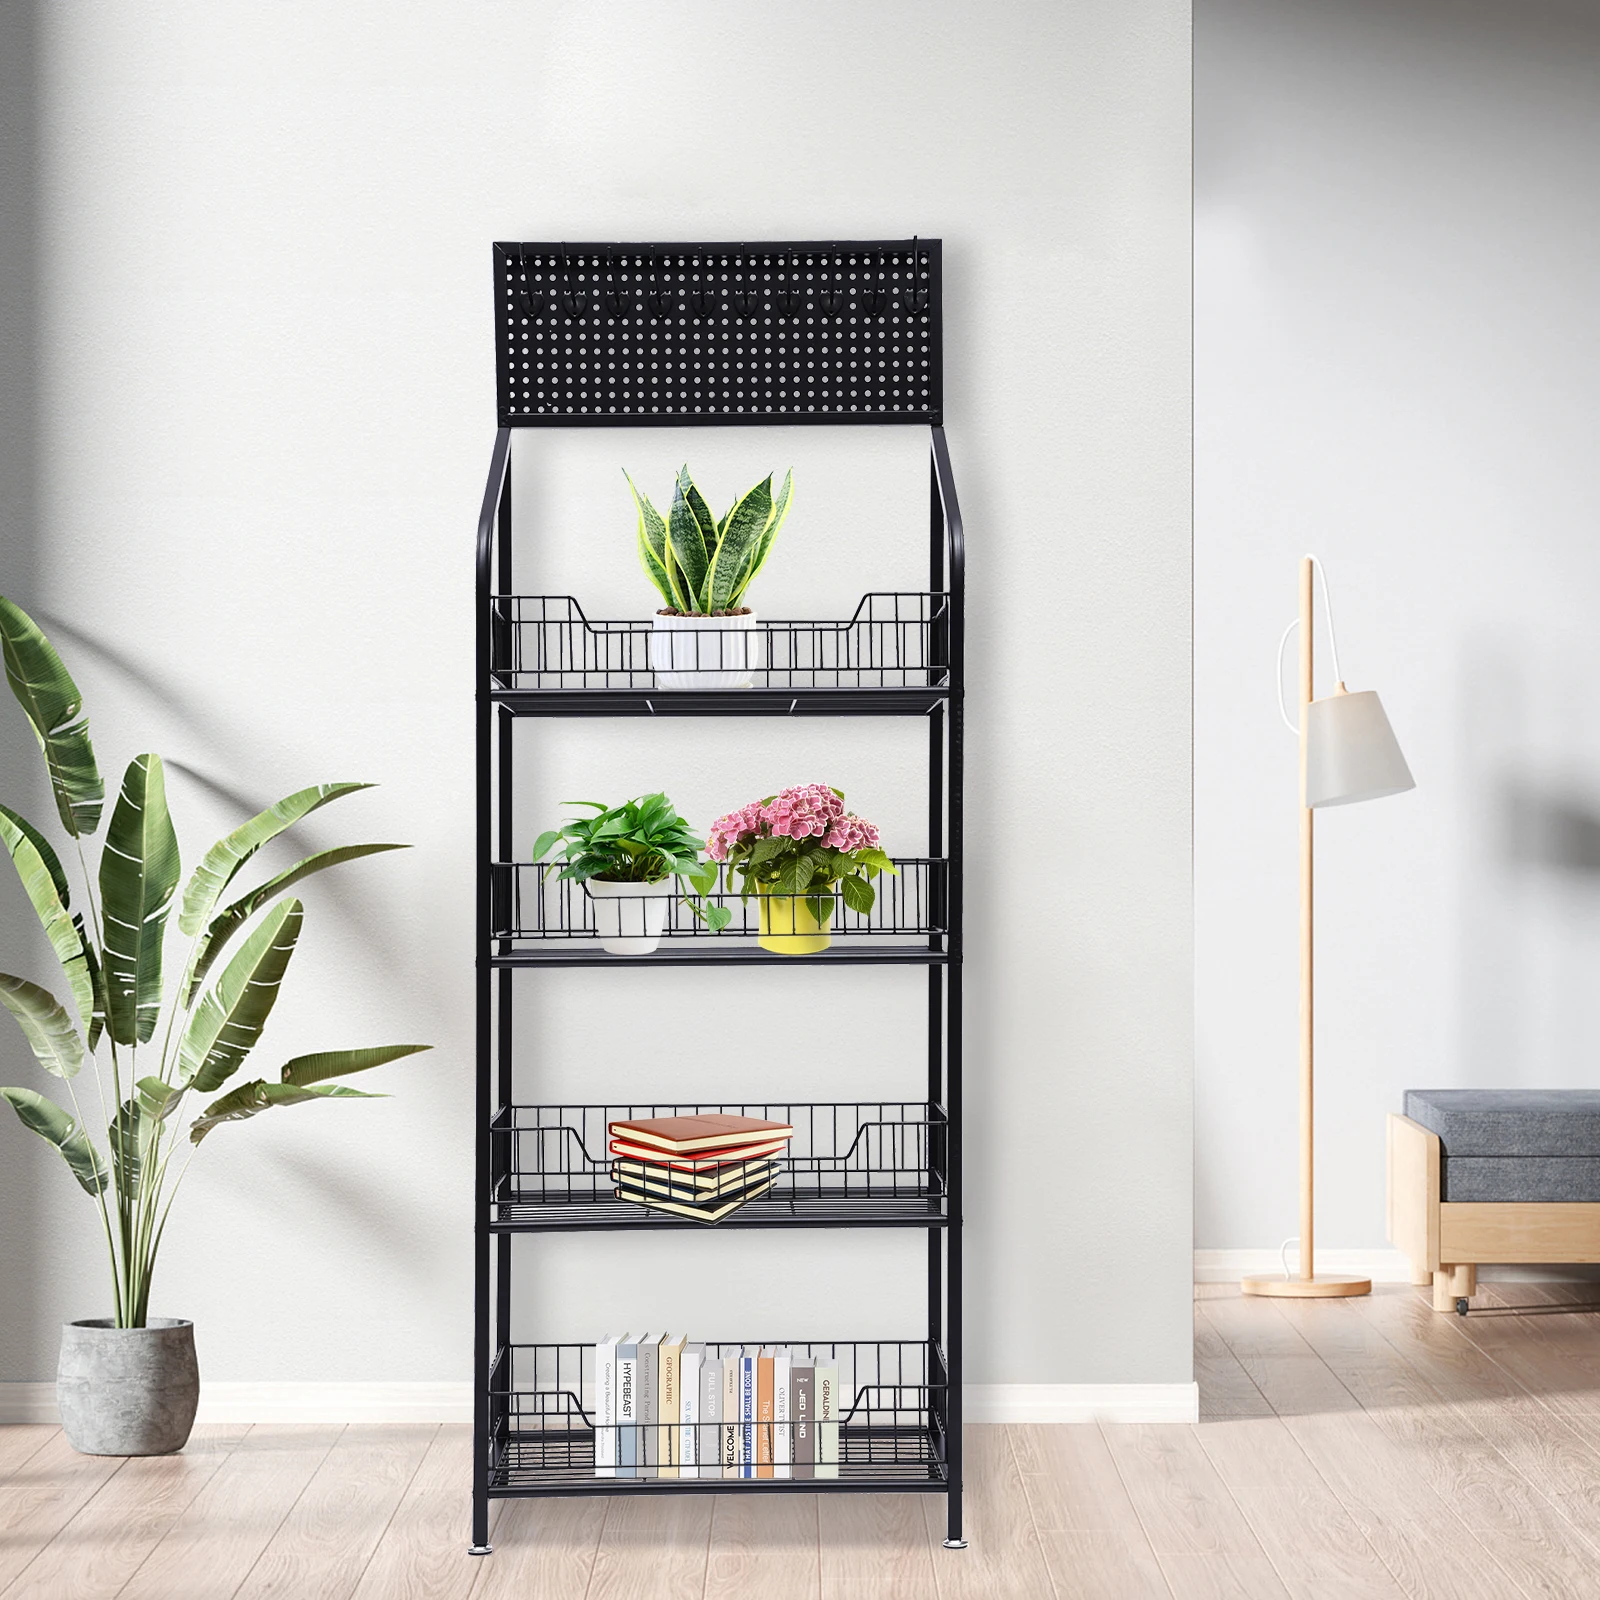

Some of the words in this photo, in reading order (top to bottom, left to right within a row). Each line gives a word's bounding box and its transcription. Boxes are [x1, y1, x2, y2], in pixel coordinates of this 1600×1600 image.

[708, 1371, 716, 1393] FULL
[744, 1370, 752, 1387] DONE
[622, 1362, 632, 1418] HYPEBEAST
[744, 1388, 752, 1396] BE
[778, 1387, 786, 1413] OLIVER
[708, 1394, 716, 1418] STOP.
[744, 1397, 752, 1416] SHALL
[762, 1400, 771, 1415] The
[726, 1425, 735, 1470] WELCOME
[744, 1446, 752, 1463] THAT
[762, 1442, 770, 1463] Letter
